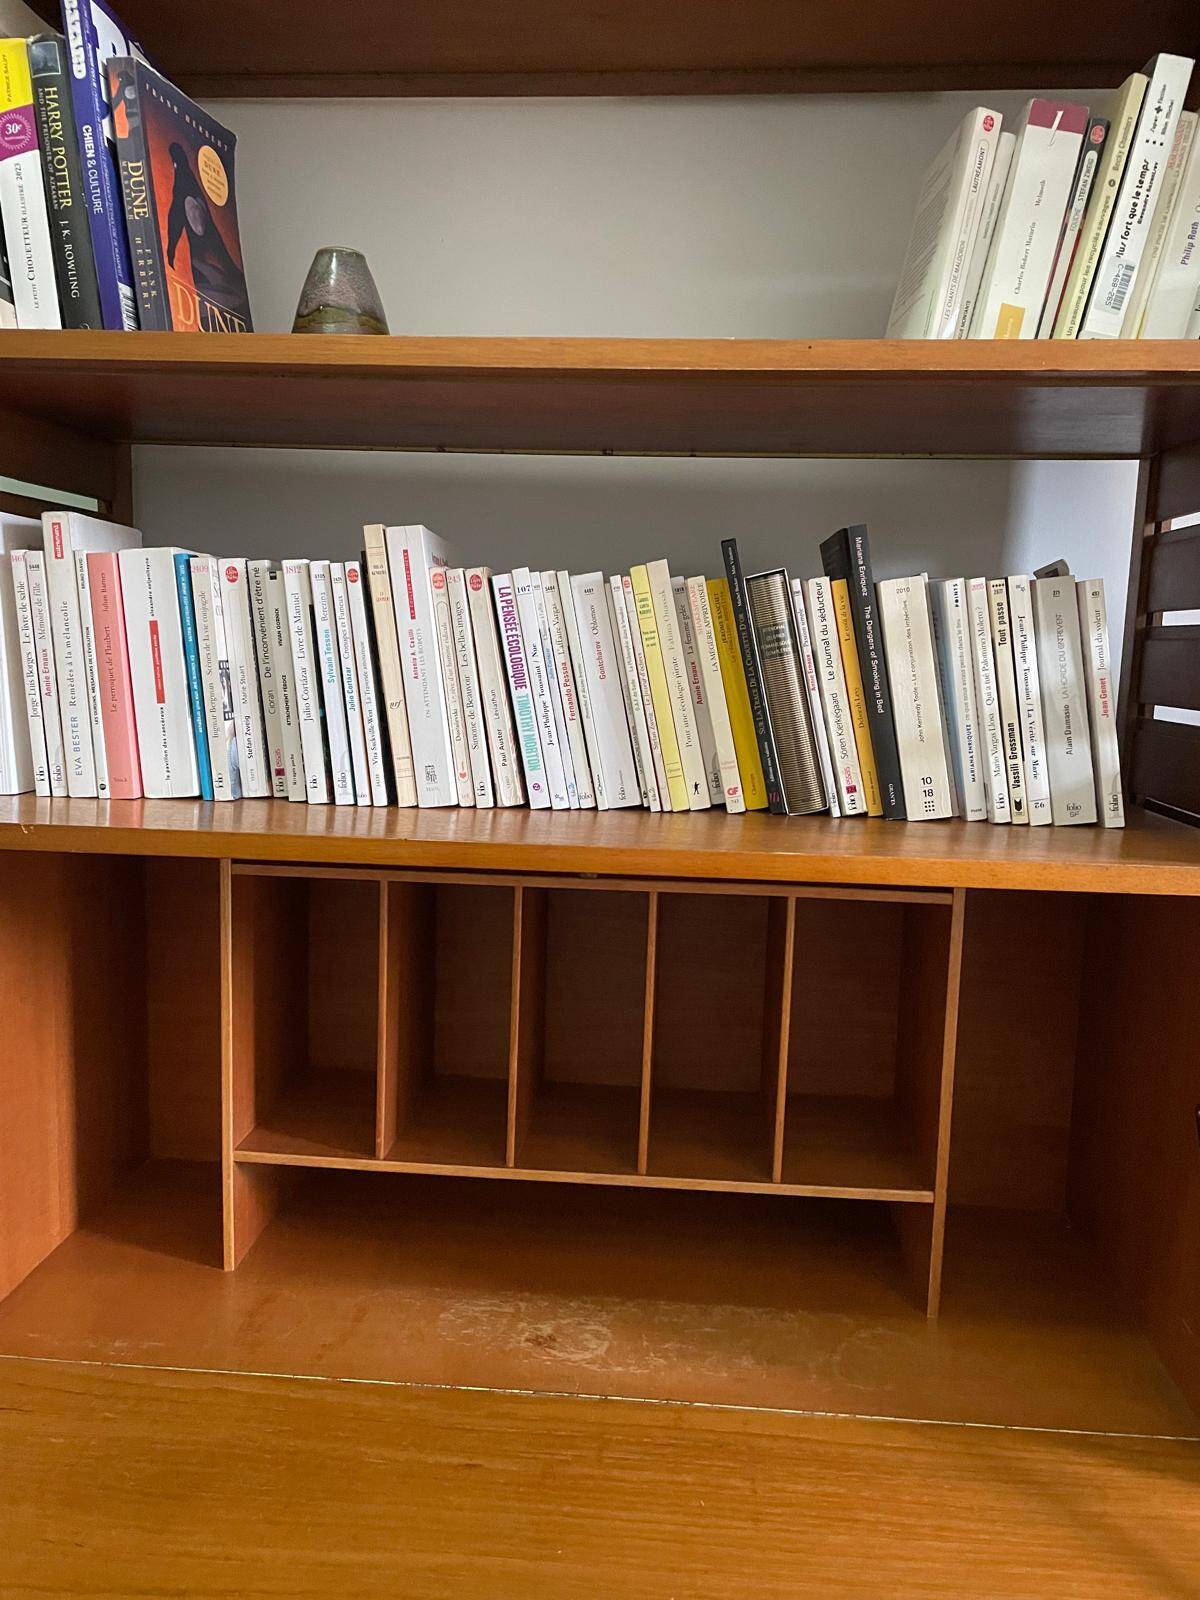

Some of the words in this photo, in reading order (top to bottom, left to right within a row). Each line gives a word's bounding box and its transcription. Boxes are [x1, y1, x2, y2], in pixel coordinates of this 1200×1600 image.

[40, 107, 48, 121] THE
[44, 86, 64, 144] HARRY
[41, 123, 51, 161] PRISONER
[82, 125, 97, 158] CHIEN
[14, 163, 22, 180] 2023
[47, 164, 53, 172] OF
[971, 147, 985, 192] LAUTRÉAMONT
[1112, 151, 1124, 171] Becky
[52, 147, 72, 210] POTTER
[1077, 180, 1089, 202] STEFAN
[1083, 158, 1094, 178] ZWEIG
[1134, 159, 1150, 189] temps
[50, 176, 59, 210] AZKABAN
[88, 169, 102, 214] CULTURE
[127, 161, 149, 220] DUNE
[1130, 191, 1140, 199] le
[1096, 195, 1111, 230] sauvages
[1126, 202, 1139, 219] que
[59, 220, 69, 228] J.
[62, 230, 71, 240] K.
[1120, 222, 1132, 240] fort
[1187, 222, 1199, 240] Roth
[22, 218, 35, 280] CHOUETTEUR
[1014, 271, 1024, 294] Charles
[1020, 248, 1030, 269] Robert
[1026, 222, 1036, 245] Maturin
[1086, 233, 1101, 263] recyclés
[1116, 242, 1126, 258] lus
[1181, 242, 1194, 265] Philip
[64, 245, 79, 298] ROWLING
[134, 236, 150, 309] HERBERT
[145, 249, 157, 296] FRANK
[947, 285, 956, 307] CHANTS
[954, 240, 965, 272] MALDOROR
[1083, 265, 1091, 276] les
[1077, 279, 1087, 293] pour
[961, 301, 971, 327] MONTANTE
[1071, 296, 1083, 324] psaume
[1066, 327, 1073, 336] Un
[855, 537, 863, 566] Mariana
[252, 567, 260, 578] né
[856, 567, 868, 597] Enriquez
[17, 581, 25, 600] sable
[255, 581, 263, 604] d'être
[498, 586, 512, 598] LA
[816, 582, 827, 623] séducteur
[19, 602, 27, 612] de
[291, 593, 301, 622] Manuel
[320, 592, 328, 621] Berezina
[455, 601, 464, 627] images
[501, 599, 519, 633] PENSÉE
[551, 603, 560, 625] Vargas
[680, 604, 689, 620] gelée
[690, 585, 703, 634] SHAKESPEARE
[697, 582, 711, 628] APPRIVOISÉE
[996, 602, 1005, 625] passe
[20, 615, 29, 631] livre
[294, 626, 303, 635] de
[589, 605, 599, 635] Oblomov
[820, 625, 828, 635] du
[23, 633, 30, 644] Le
[104, 626, 112, 655] Flaubert
[255, 606, 269, 665] l'inconvénient
[323, 630, 331, 655] Tesson
[456, 630, 466, 651] belles
[556, 628, 565, 655] L'affaire
[682, 622, 691, 644] femme
[705, 630, 716, 659] MÉGÈRE
[866, 621, 876, 649] Dangers
[998, 629, 1007, 646] Tout
[1095, 633, 1102, 642] du
[107, 657, 113, 665] de
[296, 638, 305, 659] Livre
[595, 641, 606, 679] Gontcharov
[687, 646, 693, 654] La
[822, 638, 833, 668] Journal
[1096, 645, 1106, 670] Journal
[24, 652, 35, 678] Borges
[264, 667, 271, 678] De
[325, 656, 336, 684] Sylvain
[507, 634, 527, 690] ÉCOLOGIQUE
[562, 662, 570, 687] Pessoa
[672, 656, 682, 678] pirate
[690, 662, 699, 684] Ernaux
[712, 660, 718, 672] LA
[108, 667, 118, 702] perroquet
[300, 667, 309, 700] Cortázar
[827, 671, 834, 680] Le
[870, 660, 880, 690] Smoking
[27, 680, 36, 696] Luis
[464, 675, 474, 707] Beauvoir
[675, 680, 687, 711] écologie
[694, 686, 703, 704] Annie
[1099, 678, 1107, 699] Genet
[30, 697, 39, 718] Jorge
[110, 704, 117, 712] Le
[267, 690, 275, 714] Cioran
[304, 703, 314, 721] Julio
[490, 690, 500, 719] Léviathan
[516, 694, 534, 732] TIMOTHY
[566, 689, 575, 721] Fernando
[830, 693, 844, 736] Kierkegaard
[1101, 701, 1109, 718] Jean
[245, 716, 253, 736] Zweig
[469, 711, 476, 719] de
[471, 722, 480, 749] Simone
[685, 730, 693, 747] Pour
[1007, 723, 1017, 759] Grossman
[523, 734, 539, 771] MORTON
[921, 777, 932, 785] 10
[1009, 764, 1020, 789] Vassili
[728, 787, 738, 795] GF
[923, 789, 933, 797] 18
[1109, 795, 1119, 812] folio
